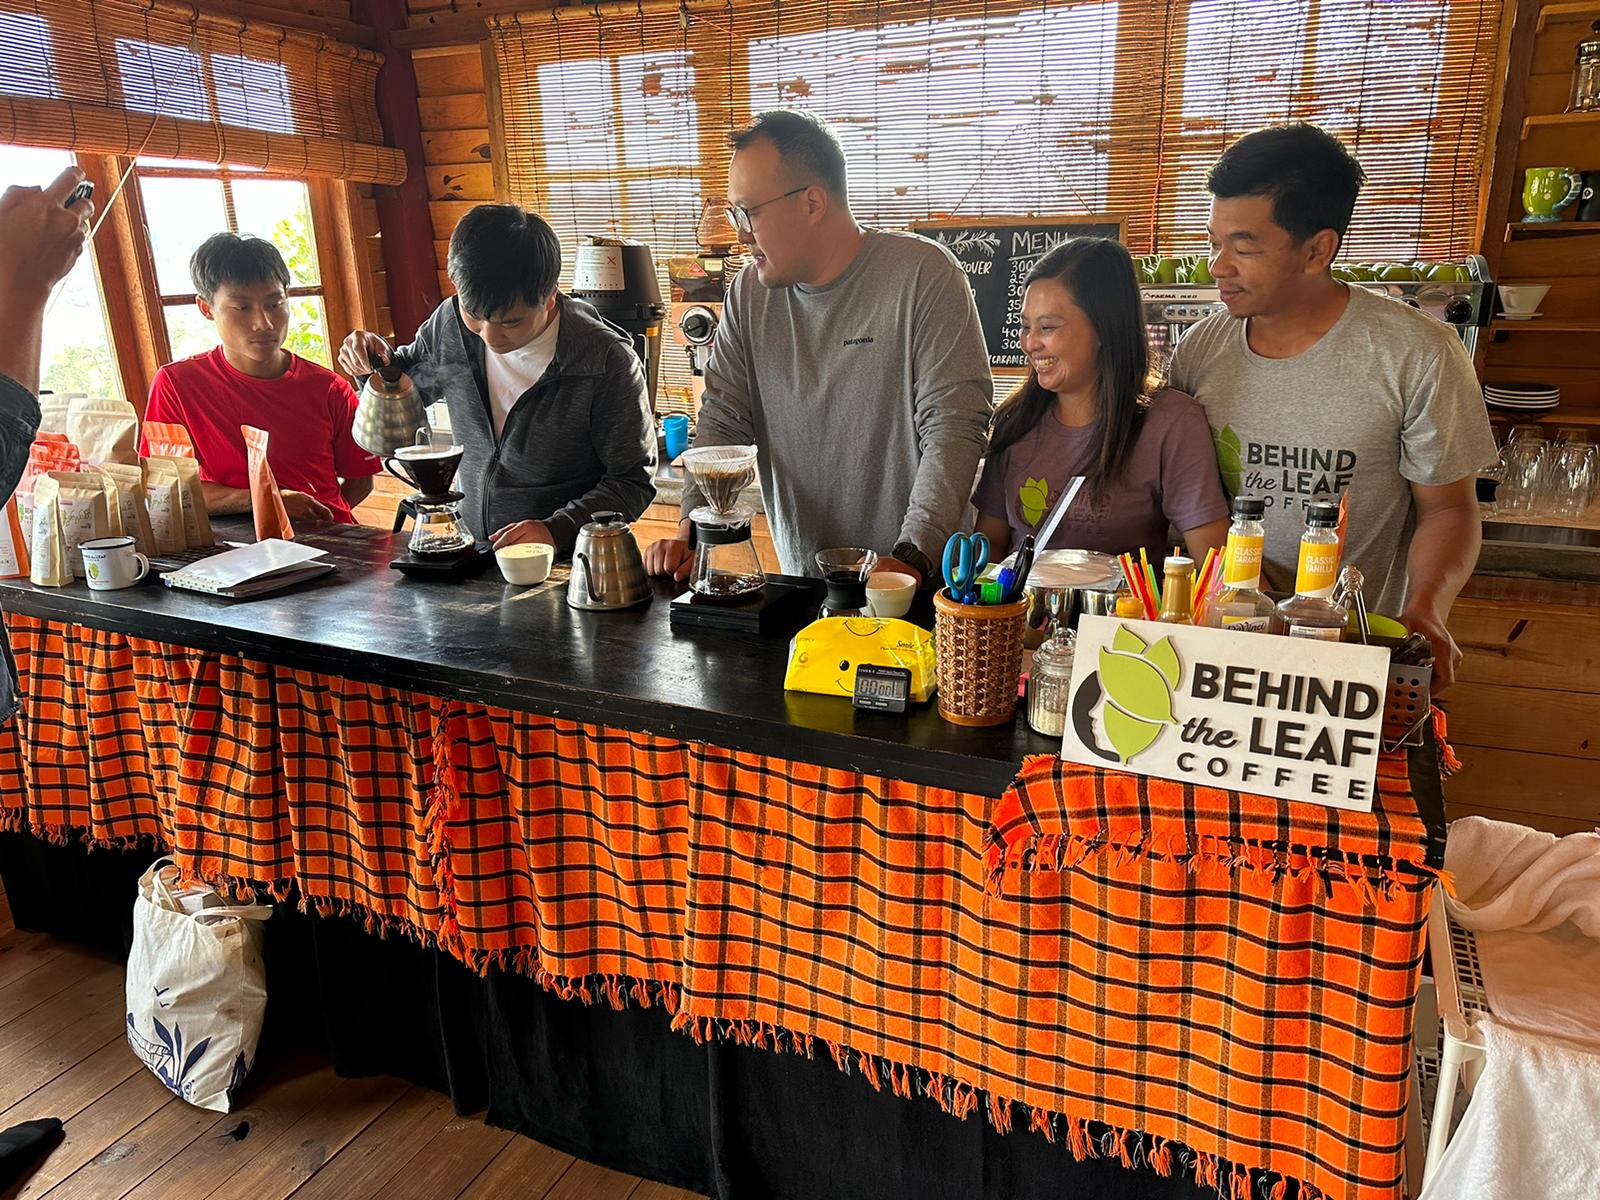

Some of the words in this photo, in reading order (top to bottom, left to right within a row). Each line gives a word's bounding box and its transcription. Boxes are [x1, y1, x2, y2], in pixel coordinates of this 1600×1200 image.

[1008, 285, 1024, 296] 30
[1010, 273, 1026, 284] 25
[1006, 313, 1022, 324] 35
[1008, 300, 1022, 311] 35
[1247, 443, 1357, 472] BEHIND
[1245, 471, 1277, 490] the
[1281, 469, 1353, 495] LEAF
[1191, 662, 1379, 720] BEHIND
[1180, 717, 1237, 748] the
[1249, 716, 1375, 767] LEAF
[1176, 752, 1366, 800] COFFEE
